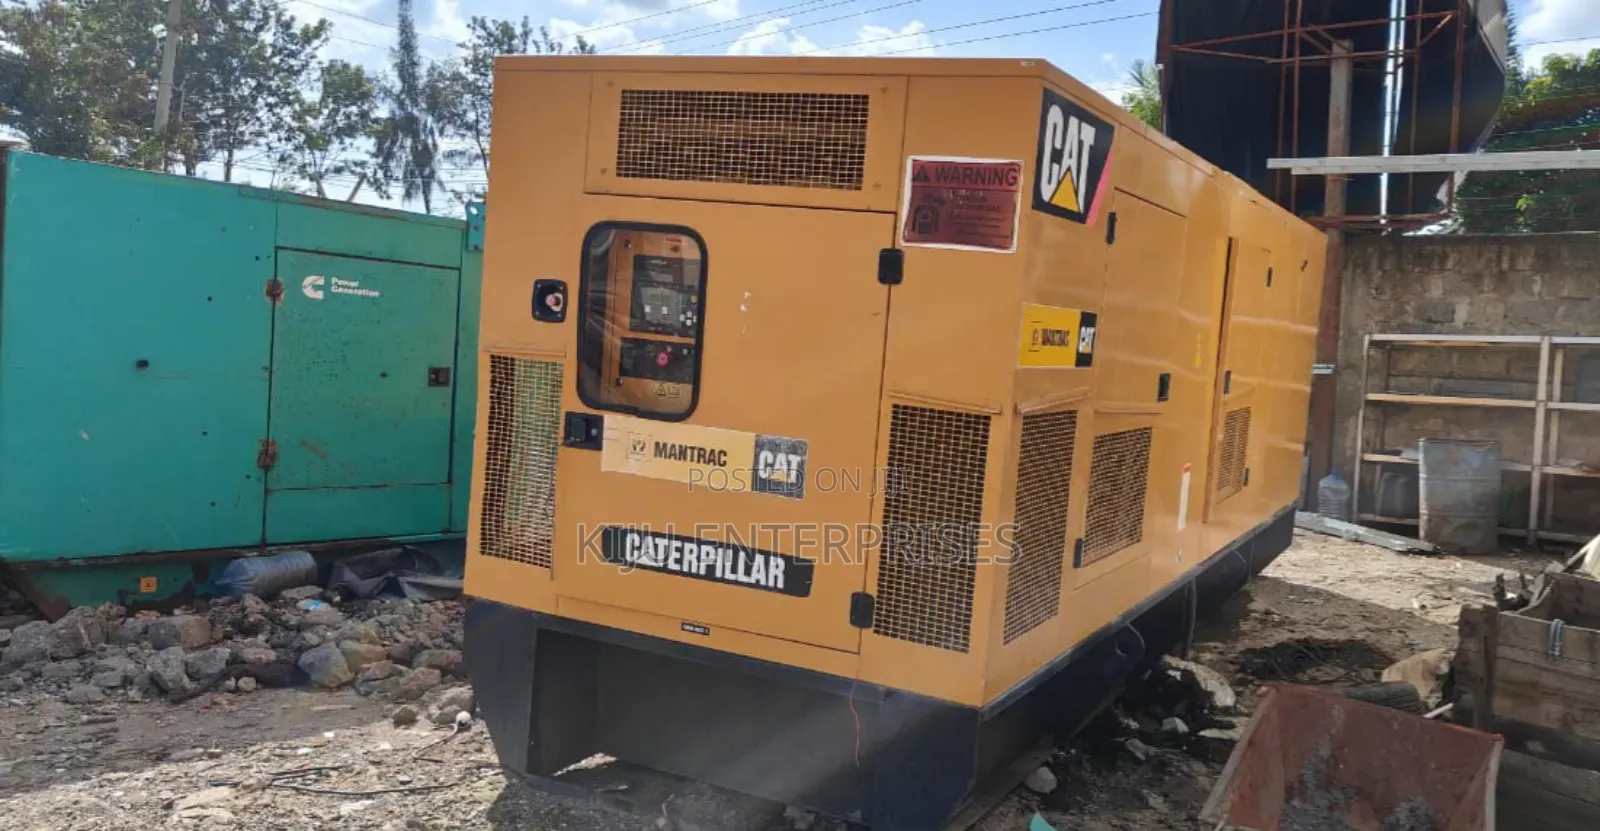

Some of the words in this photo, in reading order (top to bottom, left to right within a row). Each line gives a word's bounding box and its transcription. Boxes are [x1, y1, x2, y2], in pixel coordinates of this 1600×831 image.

[1041, 104, 1096, 213] CAT
[935, 165, 1018, 187] WARNING
[330, 285, 380, 297] Generation
[331, 276, 360, 287] Power
[654, 441, 728, 467] MANTRAC
[758, 450, 802, 483] CAT
[625, 532, 786, 589] CATERPILLAR
